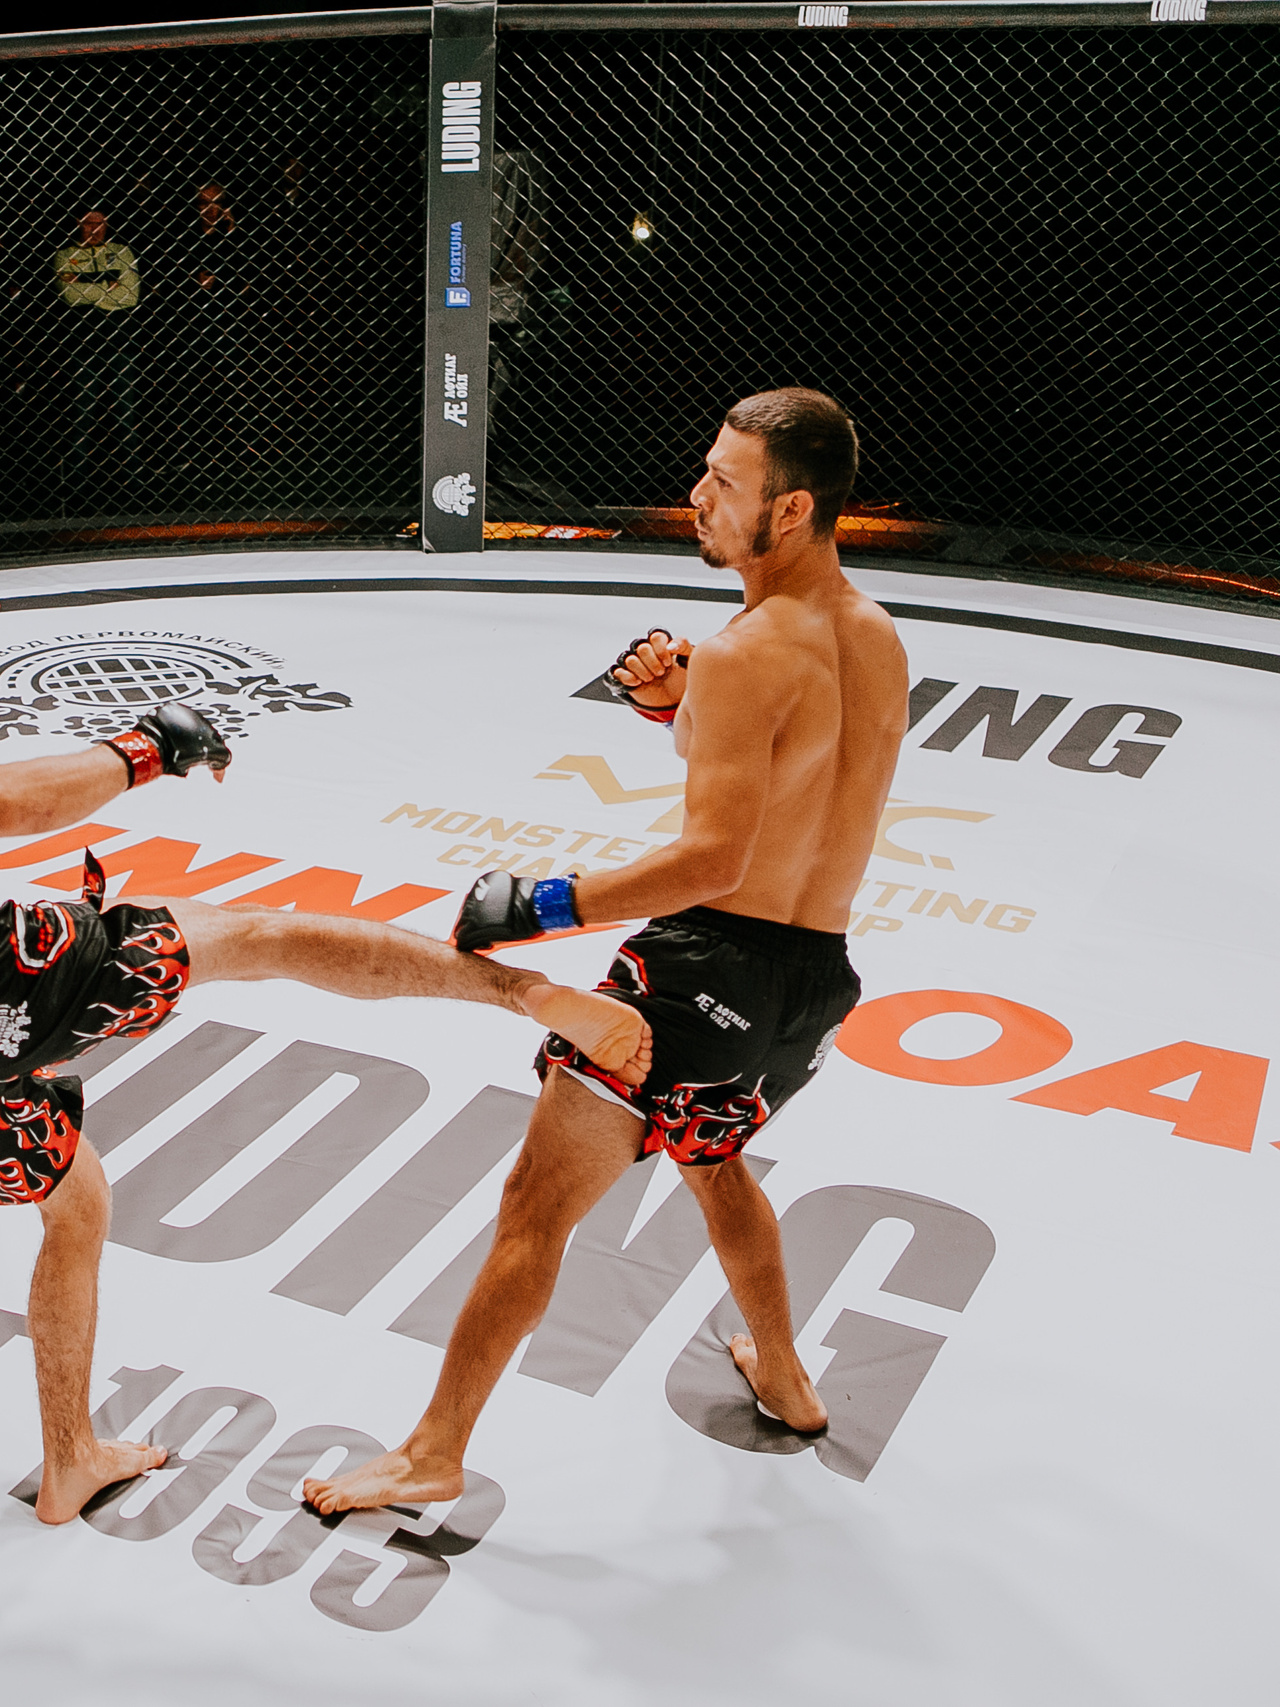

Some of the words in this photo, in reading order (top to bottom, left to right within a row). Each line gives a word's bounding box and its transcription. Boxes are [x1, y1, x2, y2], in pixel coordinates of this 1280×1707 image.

[797, 5, 849, 27] LUDING
[1150, 0, 1207, 21] LUDING
[441, 81, 481, 173] LUDING
[450, 221, 462, 284] FORTUNA
